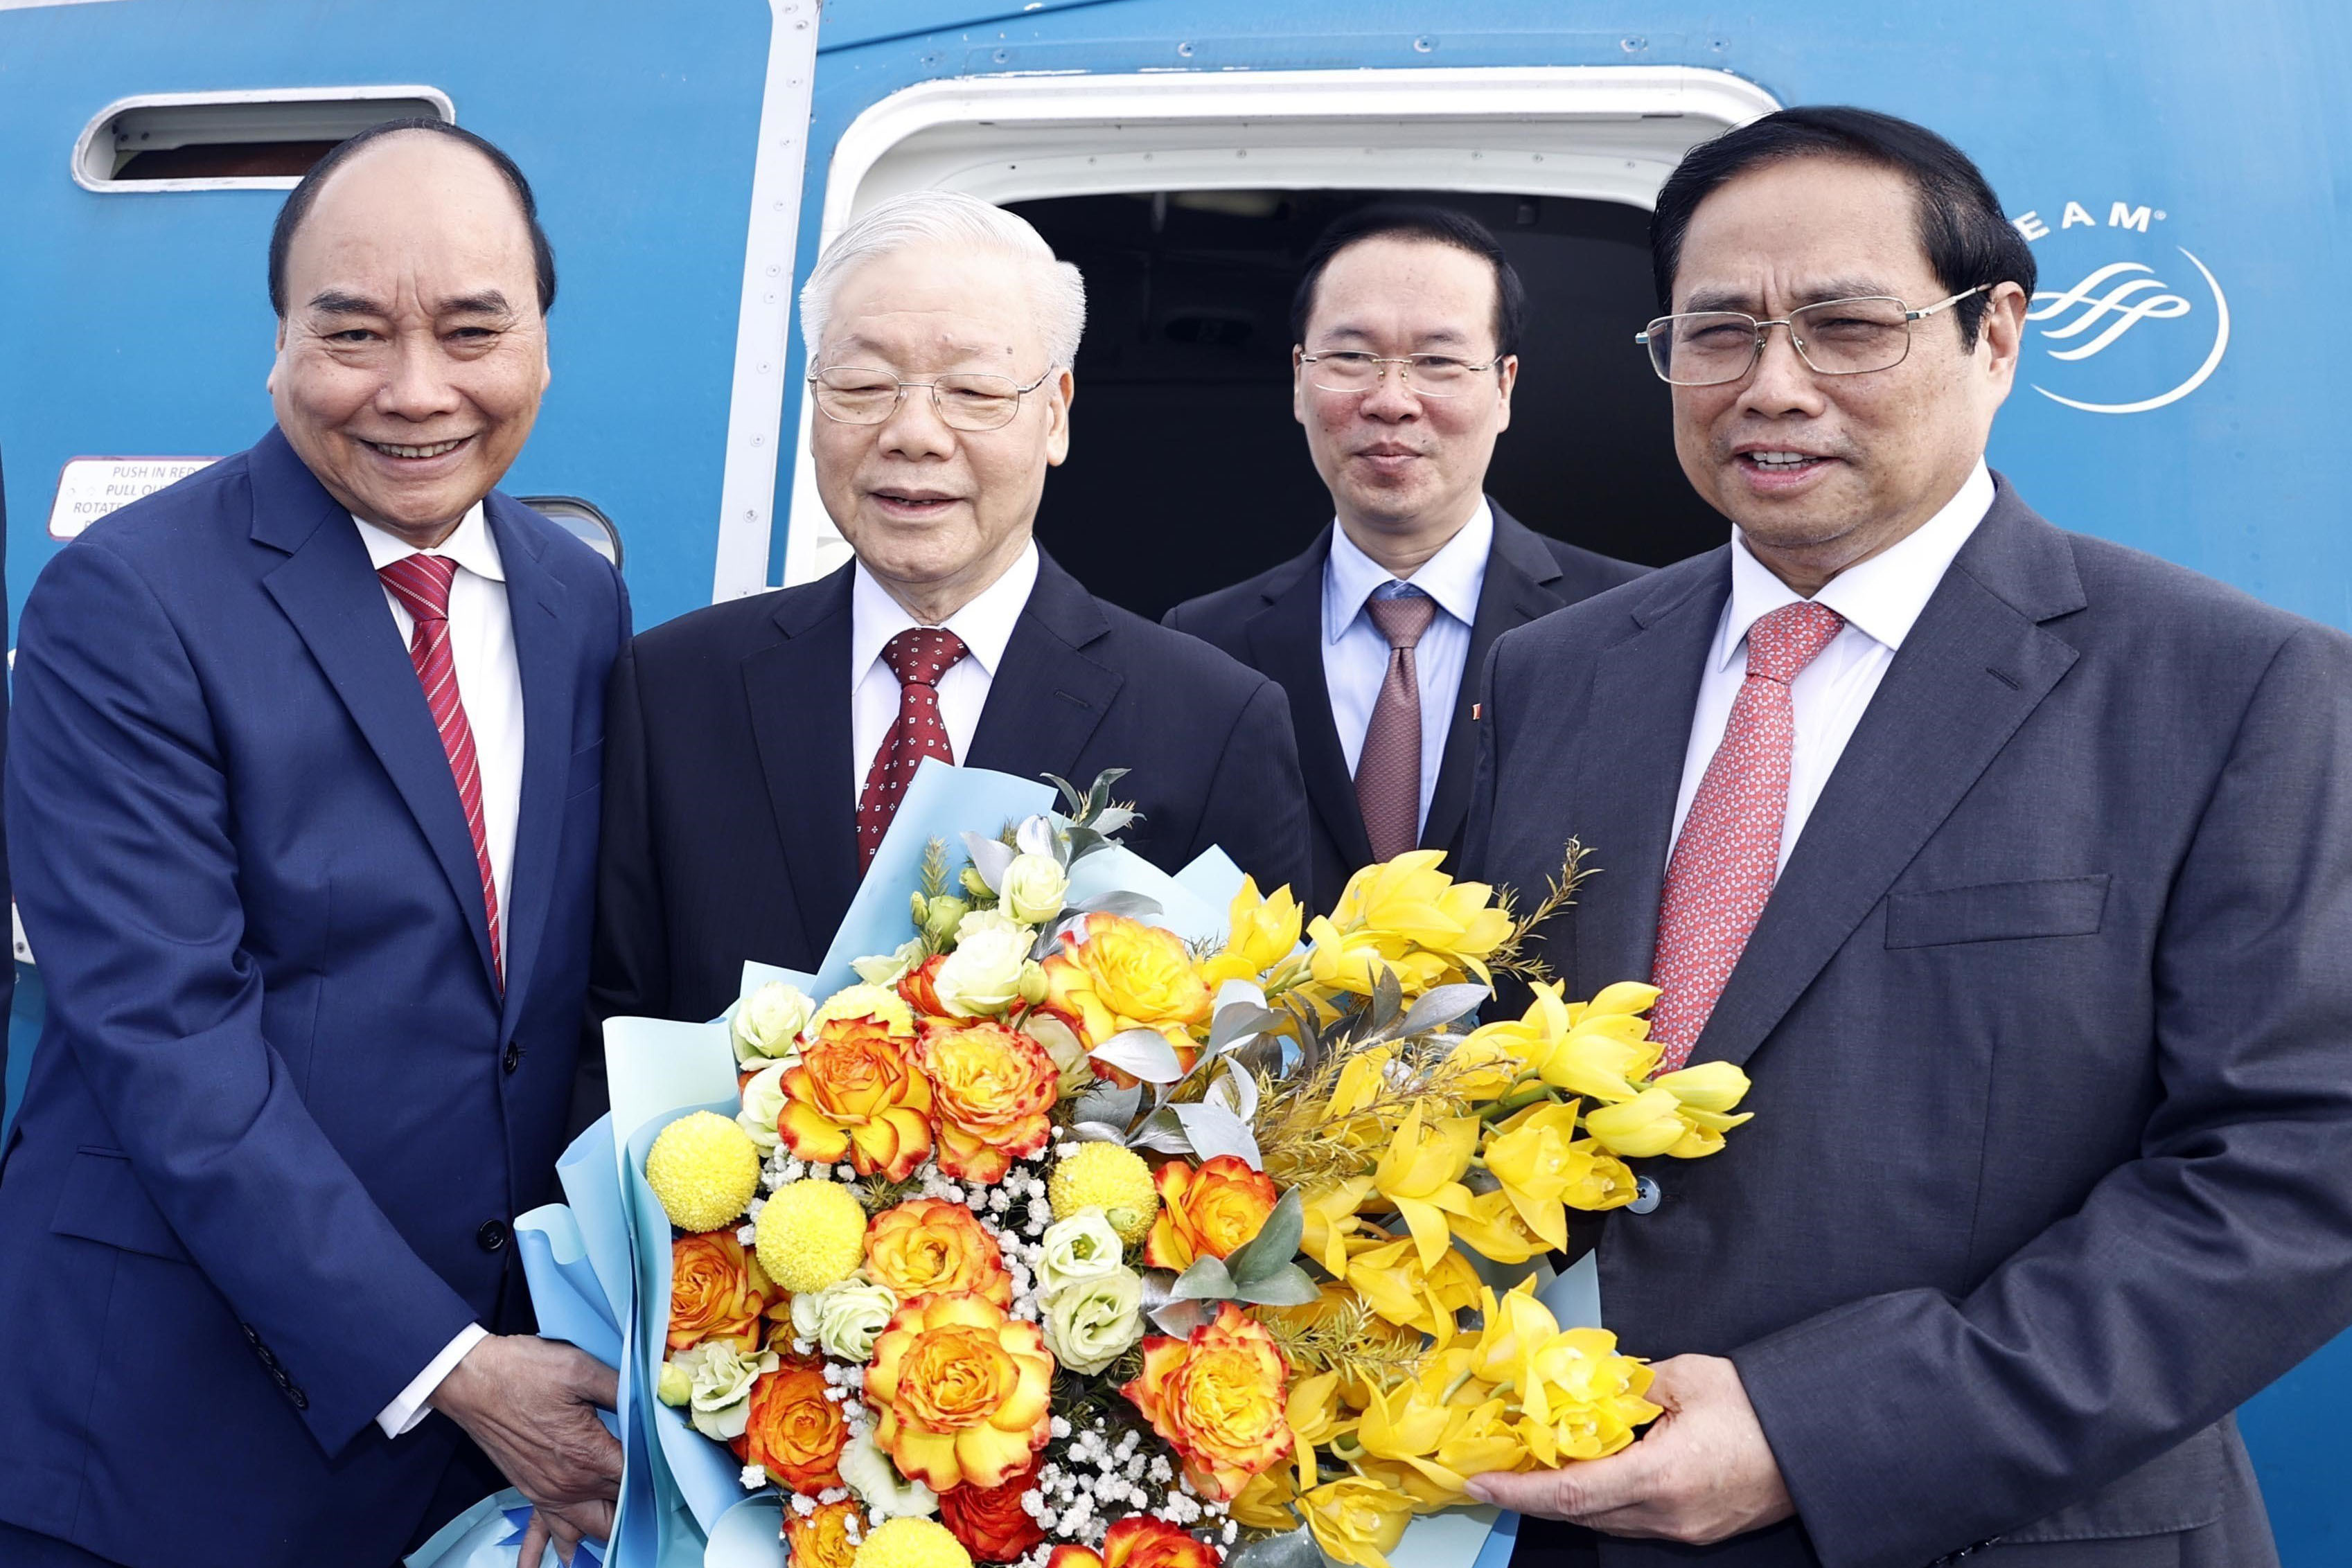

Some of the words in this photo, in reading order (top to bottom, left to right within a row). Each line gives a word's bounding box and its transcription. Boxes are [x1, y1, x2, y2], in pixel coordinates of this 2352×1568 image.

[113, 467, 148, 478] PUSH
[152, 467, 166, 478] IN
[106, 485, 137, 496] PULL
